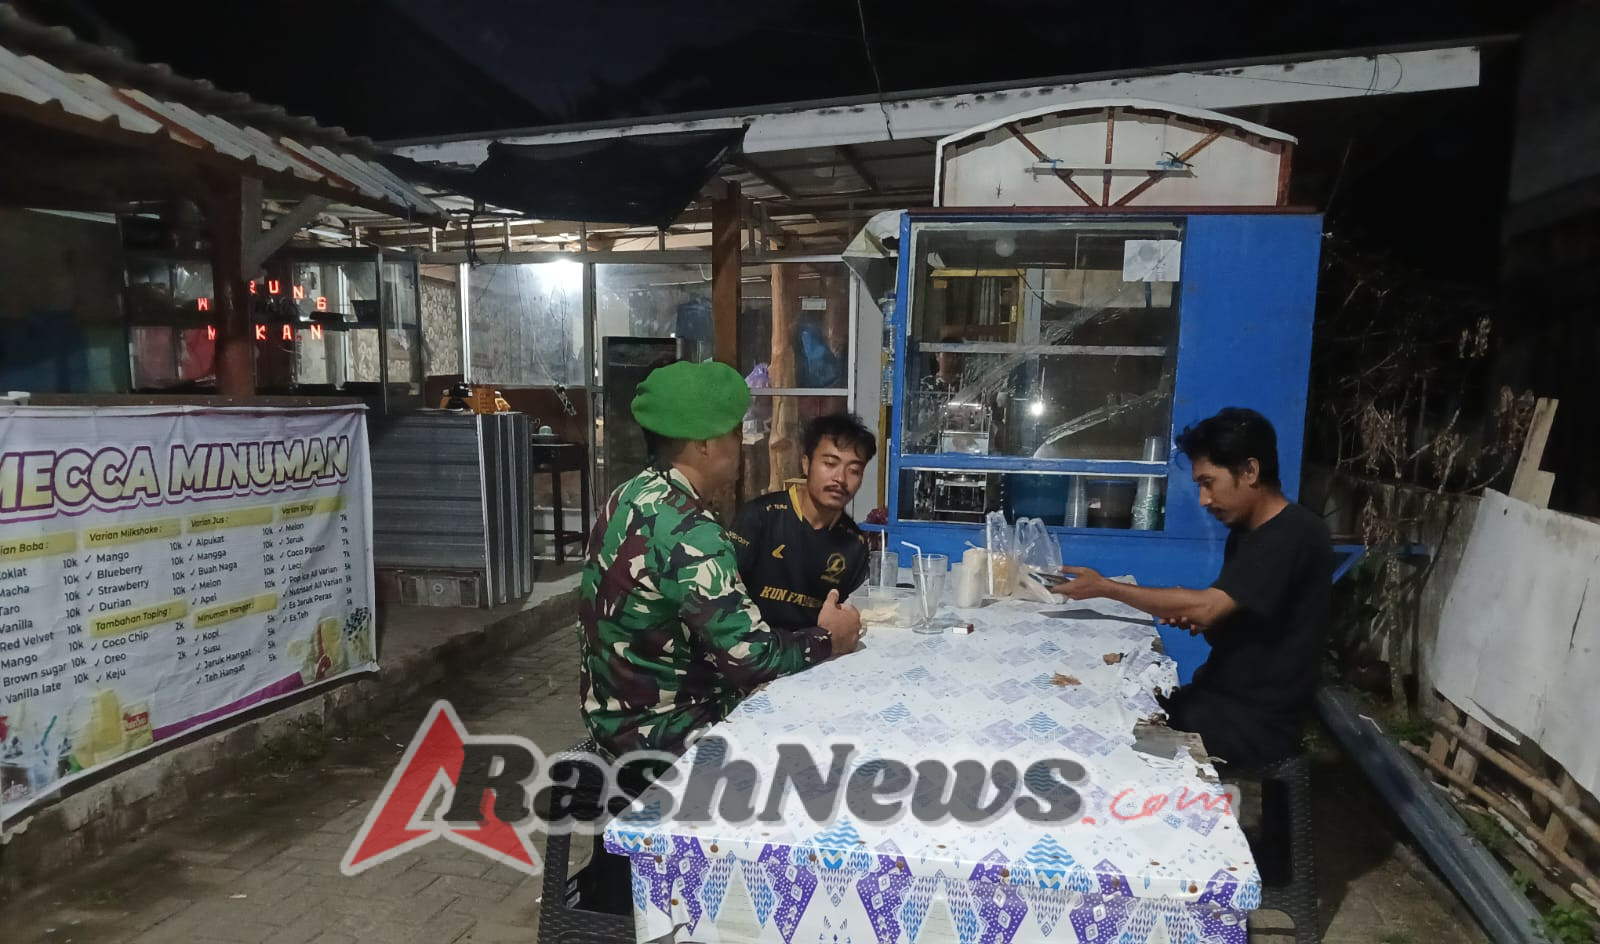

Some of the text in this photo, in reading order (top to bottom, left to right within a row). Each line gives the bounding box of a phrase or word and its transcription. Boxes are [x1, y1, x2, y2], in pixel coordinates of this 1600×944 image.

[197, 279, 328, 311] WRUNG
[207, 323, 322, 341] MKAN
[168, 435, 349, 495] MINUMAN
[89, 531, 118, 541] Varian
[121, 526, 158, 537] Milkshake
[191, 519, 211, 528] Varian
[212, 516, 225, 524] Jus
[285, 523, 305, 532] Melon
[19, 541, 44, 552] Boba
[196, 527, 273, 547] Alpukat 10k
[96, 542, 183, 563] Mango 10k
[197, 540, 273, 561] Mangga 10k
[287, 549, 304, 558] Coco
[0, 557, 78, 581] oklat 10k
[97, 556, 184, 579] Blueberry 10k
[198, 554, 274, 576] Buah Naga 10k
[288, 562, 302, 571] Leci
[63, 575, 80, 586] 10k
[97, 571, 185, 596] Strawberry 10k
[199, 567, 275, 590] Melon 10k
[322, 577, 343, 587] Varian
[64, 591, 80, 602] 10k
[99, 586, 186, 611] Durian 10k
[200, 580, 276, 604] Apel 10k
[0, 607, 81, 634] Vanilla 10k
[96, 615, 141, 631] Tambahan
[143, 608, 168, 620] Toping
[197, 608, 228, 621] Minuman
[297, 610, 309, 619] Teh
[0, 624, 82, 652] Red Velvet 10k
[102, 622, 185, 649] Coco Chip 2k
[202, 614, 276, 641] Kopi 5k
[104, 637, 186, 664] Oreo 2k
[203, 627, 276, 655] Susu 5k
[226, 648, 252, 661] Hangat
[267, 640, 276, 649] 5k
[1, 640, 84, 669] Mango 10k
[106, 651, 187, 680] Keju 2k
[3, 656, 87, 687] Brown sugar 10k
[204, 653, 277, 683] Teh Hangat 5k
[5, 672, 89, 704] Vanilla late 10k
